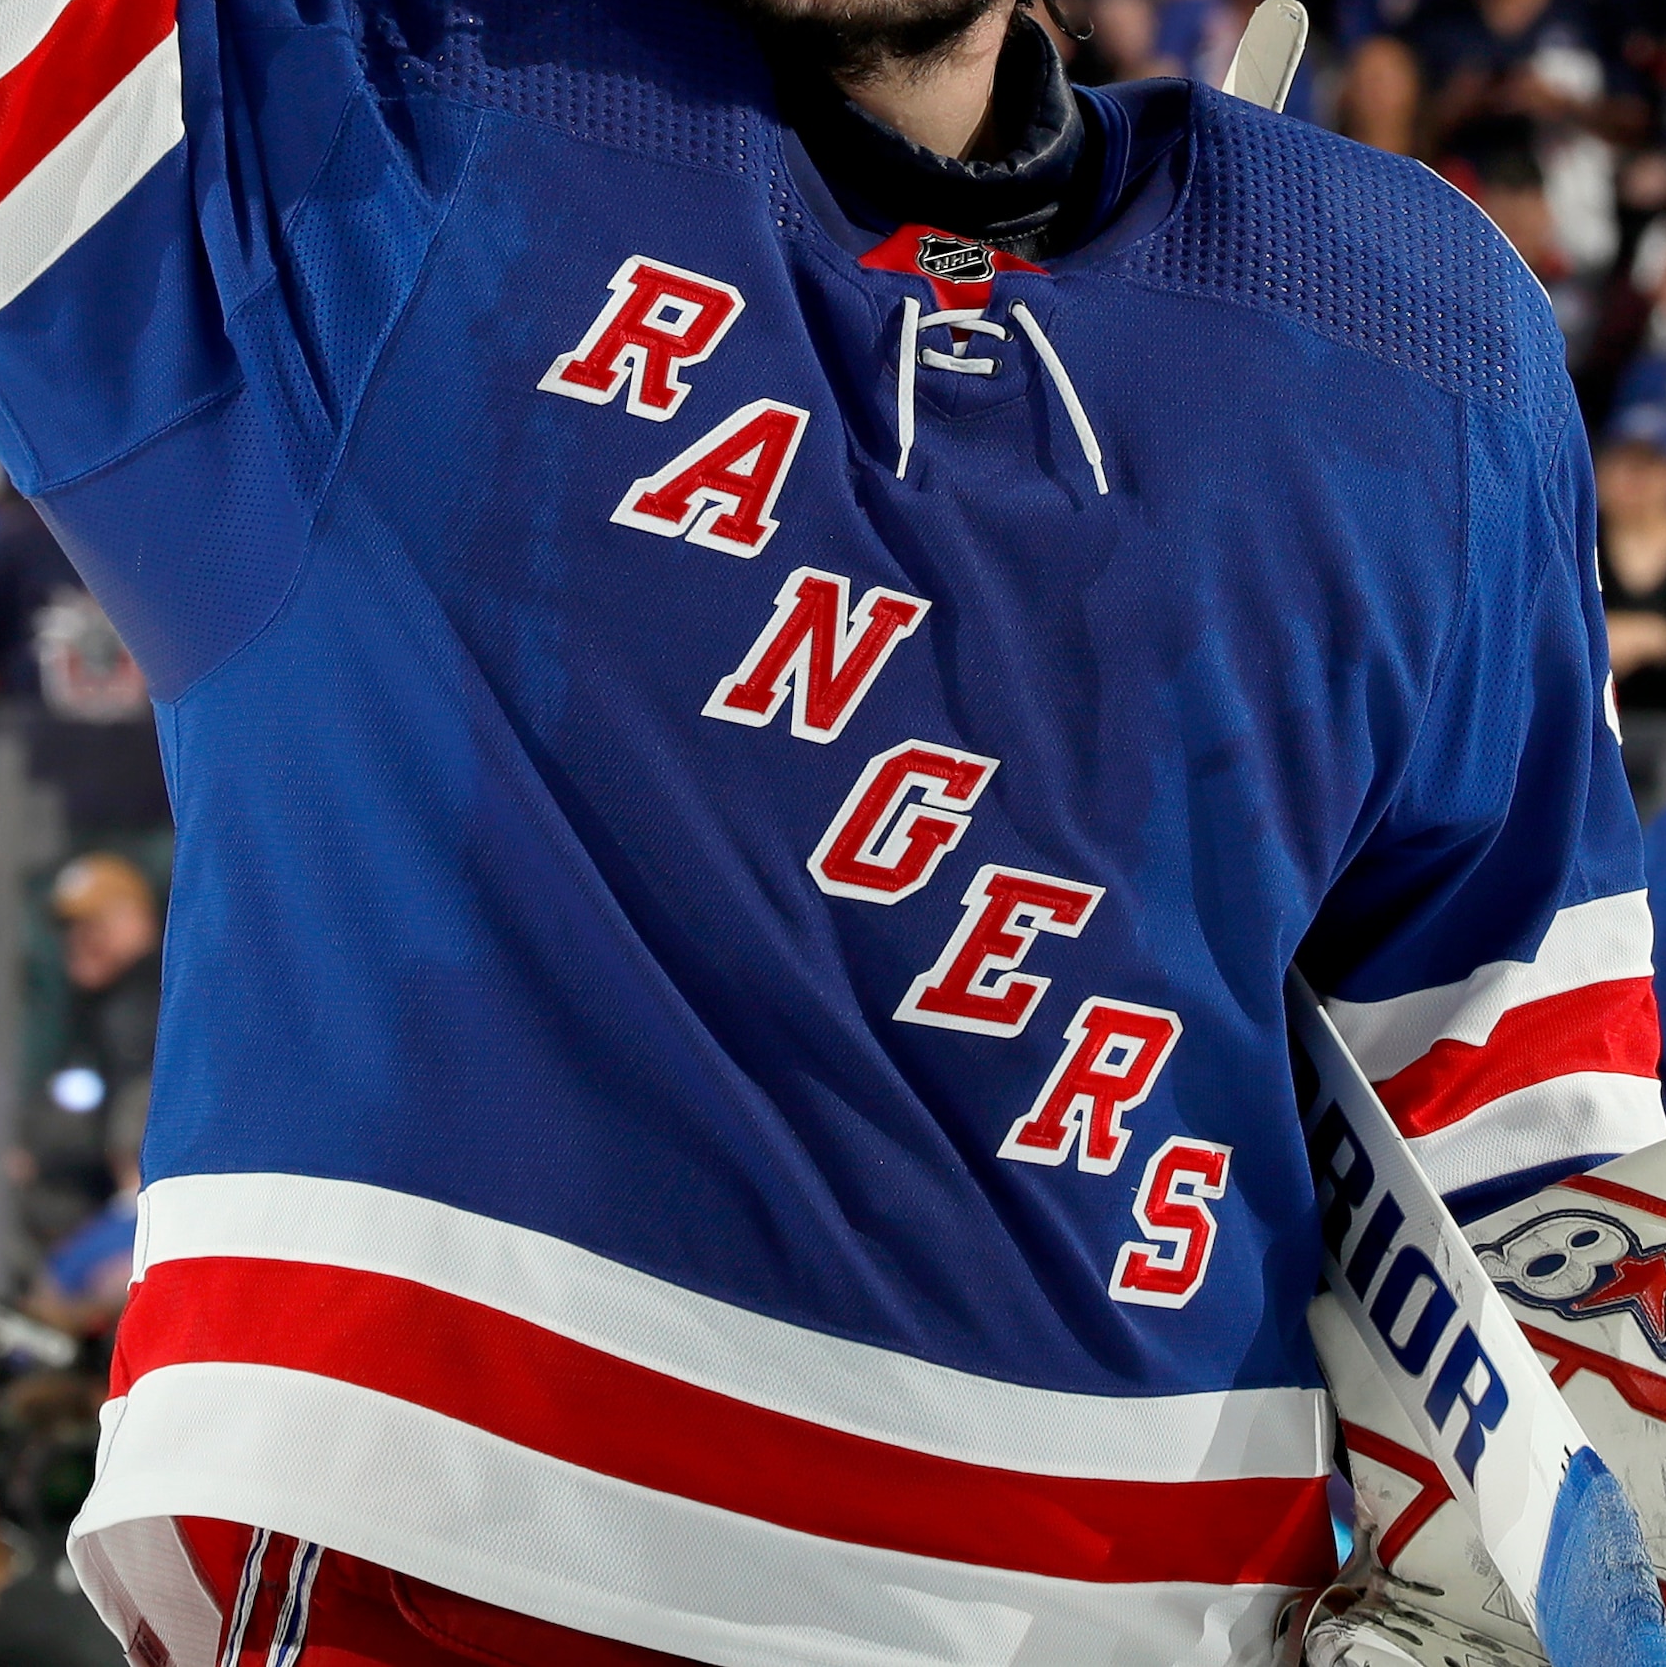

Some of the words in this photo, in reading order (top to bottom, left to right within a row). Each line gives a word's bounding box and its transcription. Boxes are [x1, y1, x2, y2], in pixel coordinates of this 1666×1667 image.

[934, 251, 980, 271] NHL
[537, 254, 1234, 1310] RANGERS
[1299, 1061, 1510, 1490] RIOR
